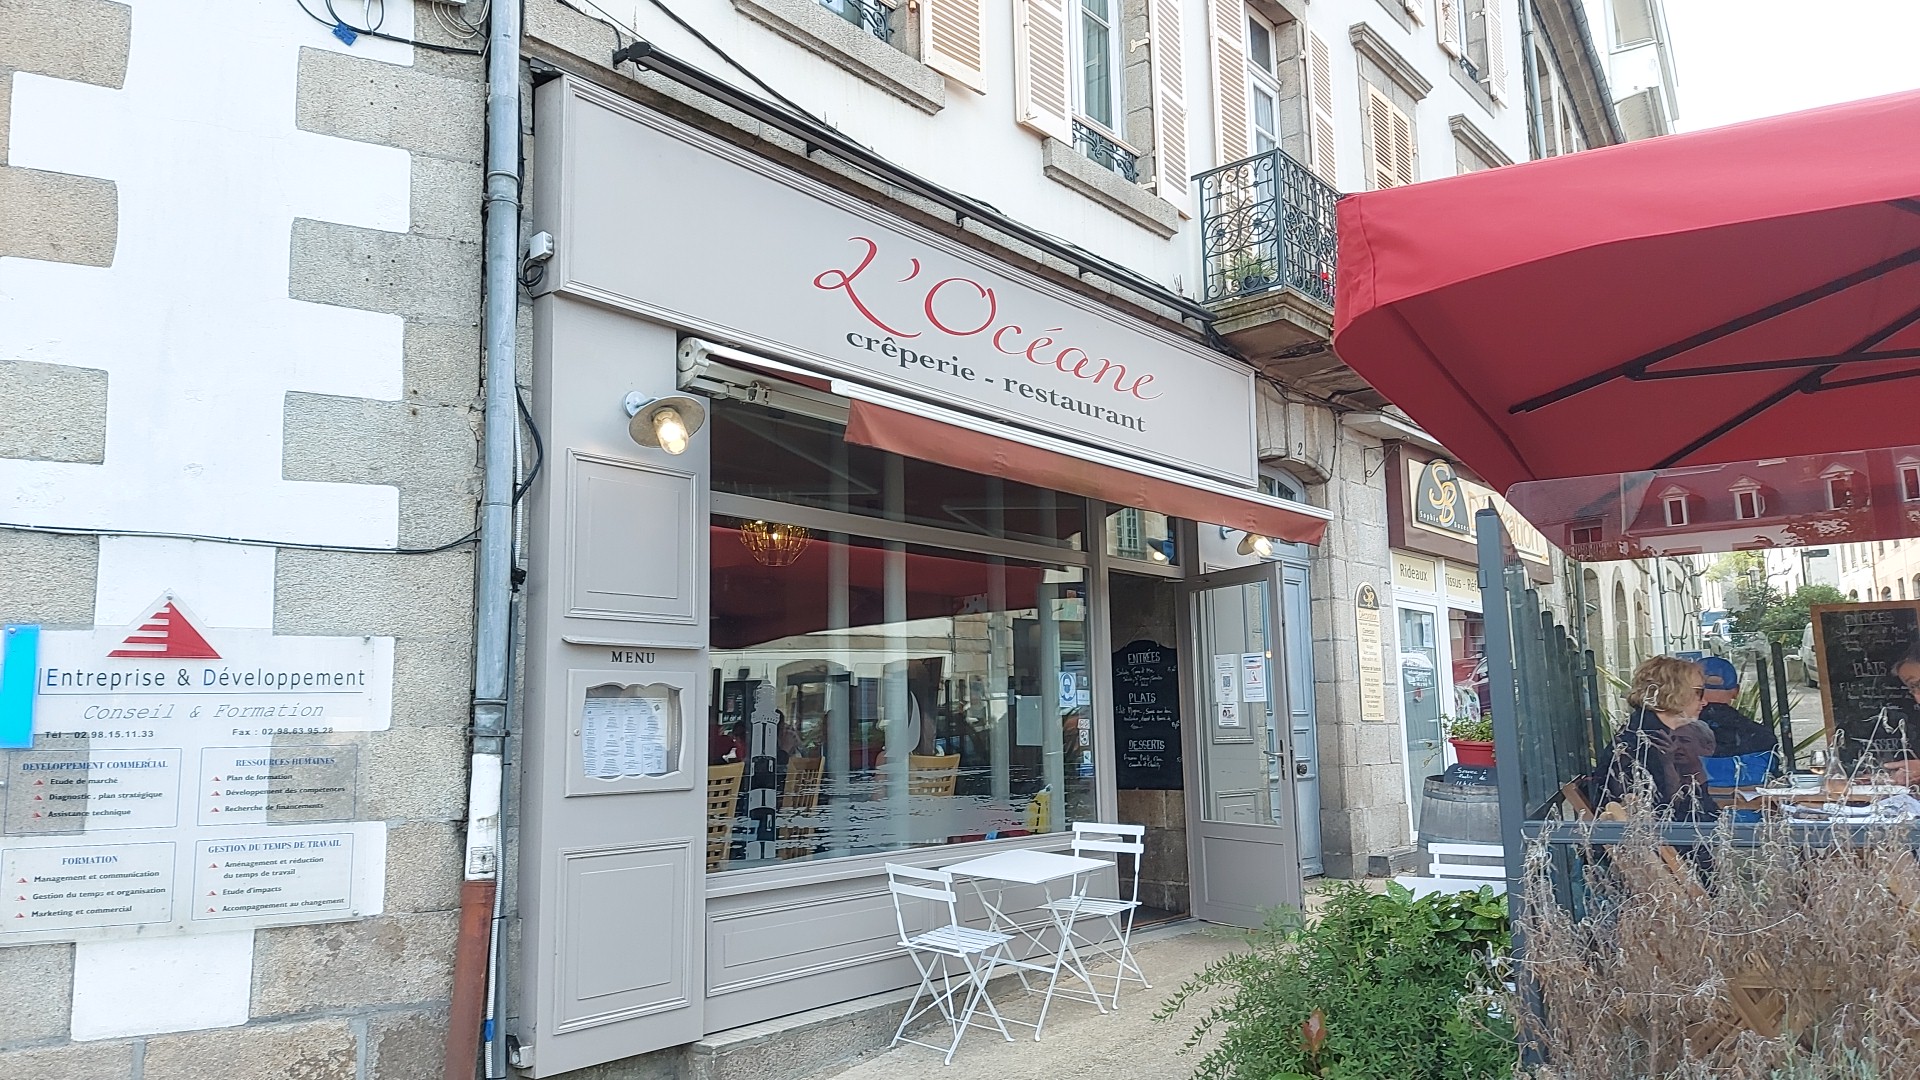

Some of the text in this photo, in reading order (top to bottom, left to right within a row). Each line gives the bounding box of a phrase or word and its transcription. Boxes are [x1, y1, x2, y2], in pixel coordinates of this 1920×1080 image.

[812, 236, 1164, 401] L'Océane
[846, 331, 976, 381] crêperie
[1002, 374, 1147, 433] restaurant
[1297, 442, 1303, 456] 2
[1419, 510, 1439, 523] Sophie
[1399, 563, 1428, 582] Rideaux
[1445, 572, 1462, 588] Tissus
[611, 651, 656, 664] MENU
[1127, 648, 1161, 664] ENTRÉES
[1853, 661, 1887, 676] PLATS
[46, 668, 366, 691] Entreprise & Développement
[1128, 692, 1157, 704] PLATS
[83, 704, 325, 720] Conseil & Formation
[74, 730, 155, 739] 02.98.15.11.33
[232, 728, 251, 736] Fax
[261, 727, 334, 736] 02.98.63.95.28
[1128, 739, 1166, 751] DESSERTS
[22, 760, 169, 771] DEVELOPPEMENT COMMERCIAL
[235, 757, 335, 767] RESSOURCES HUMAINES
[256, 773, 293, 781] formation
[49, 792, 91, 802] Diagnostic
[98, 792, 116, 801] plan
[117, 791, 163, 800] stratégique
[225, 788, 283, 796] Développement
[47, 809, 131, 818] Assistance technique
[224, 804, 263, 812] Recherche
[208, 839, 342, 854] GESTION DU TEMPS DE TRAVAIL
[61, 855, 118, 865] FORMATION
[224, 859, 278, 868] Aménagement
[289, 856, 324, 864] réduction
[33, 874, 87, 884] Management
[99, 870, 160, 880] communication
[235, 872, 258, 880] temps
[272, 869, 296, 877] travail
[32, 892, 64, 900] Gestion
[79, 891, 105, 900] temps
[117, 887, 166, 897] organisation
[246, 886, 282, 896] d'impacts
[222, 901, 288, 912] Accompagnement
[301, 897, 345, 907] changement
[31, 909, 73, 918] Marketing
[86, 905, 133, 914] commercial
